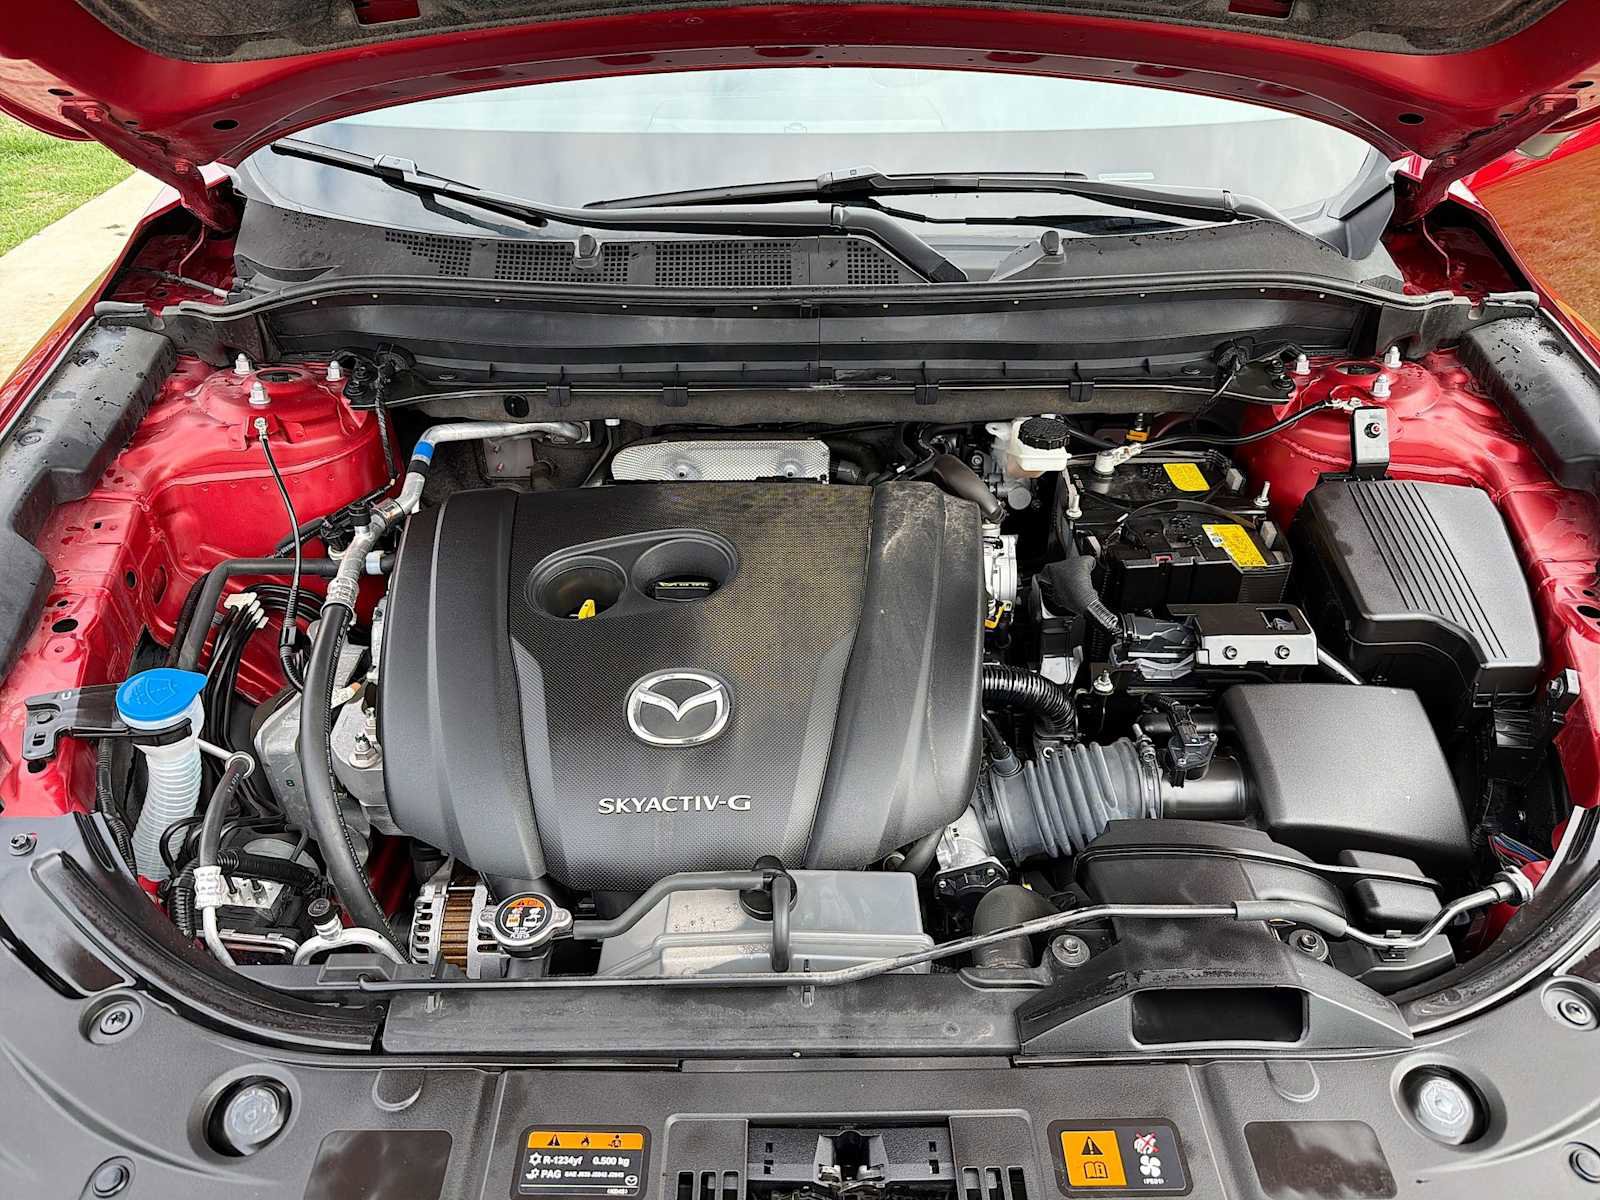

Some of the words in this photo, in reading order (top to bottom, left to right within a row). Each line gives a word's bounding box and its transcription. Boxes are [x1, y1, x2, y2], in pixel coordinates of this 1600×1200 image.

[598, 794, 751, 815] SKYACTIV-G
[618, 1156, 630, 1167] kg
[541, 1169, 561, 1178] PAG
